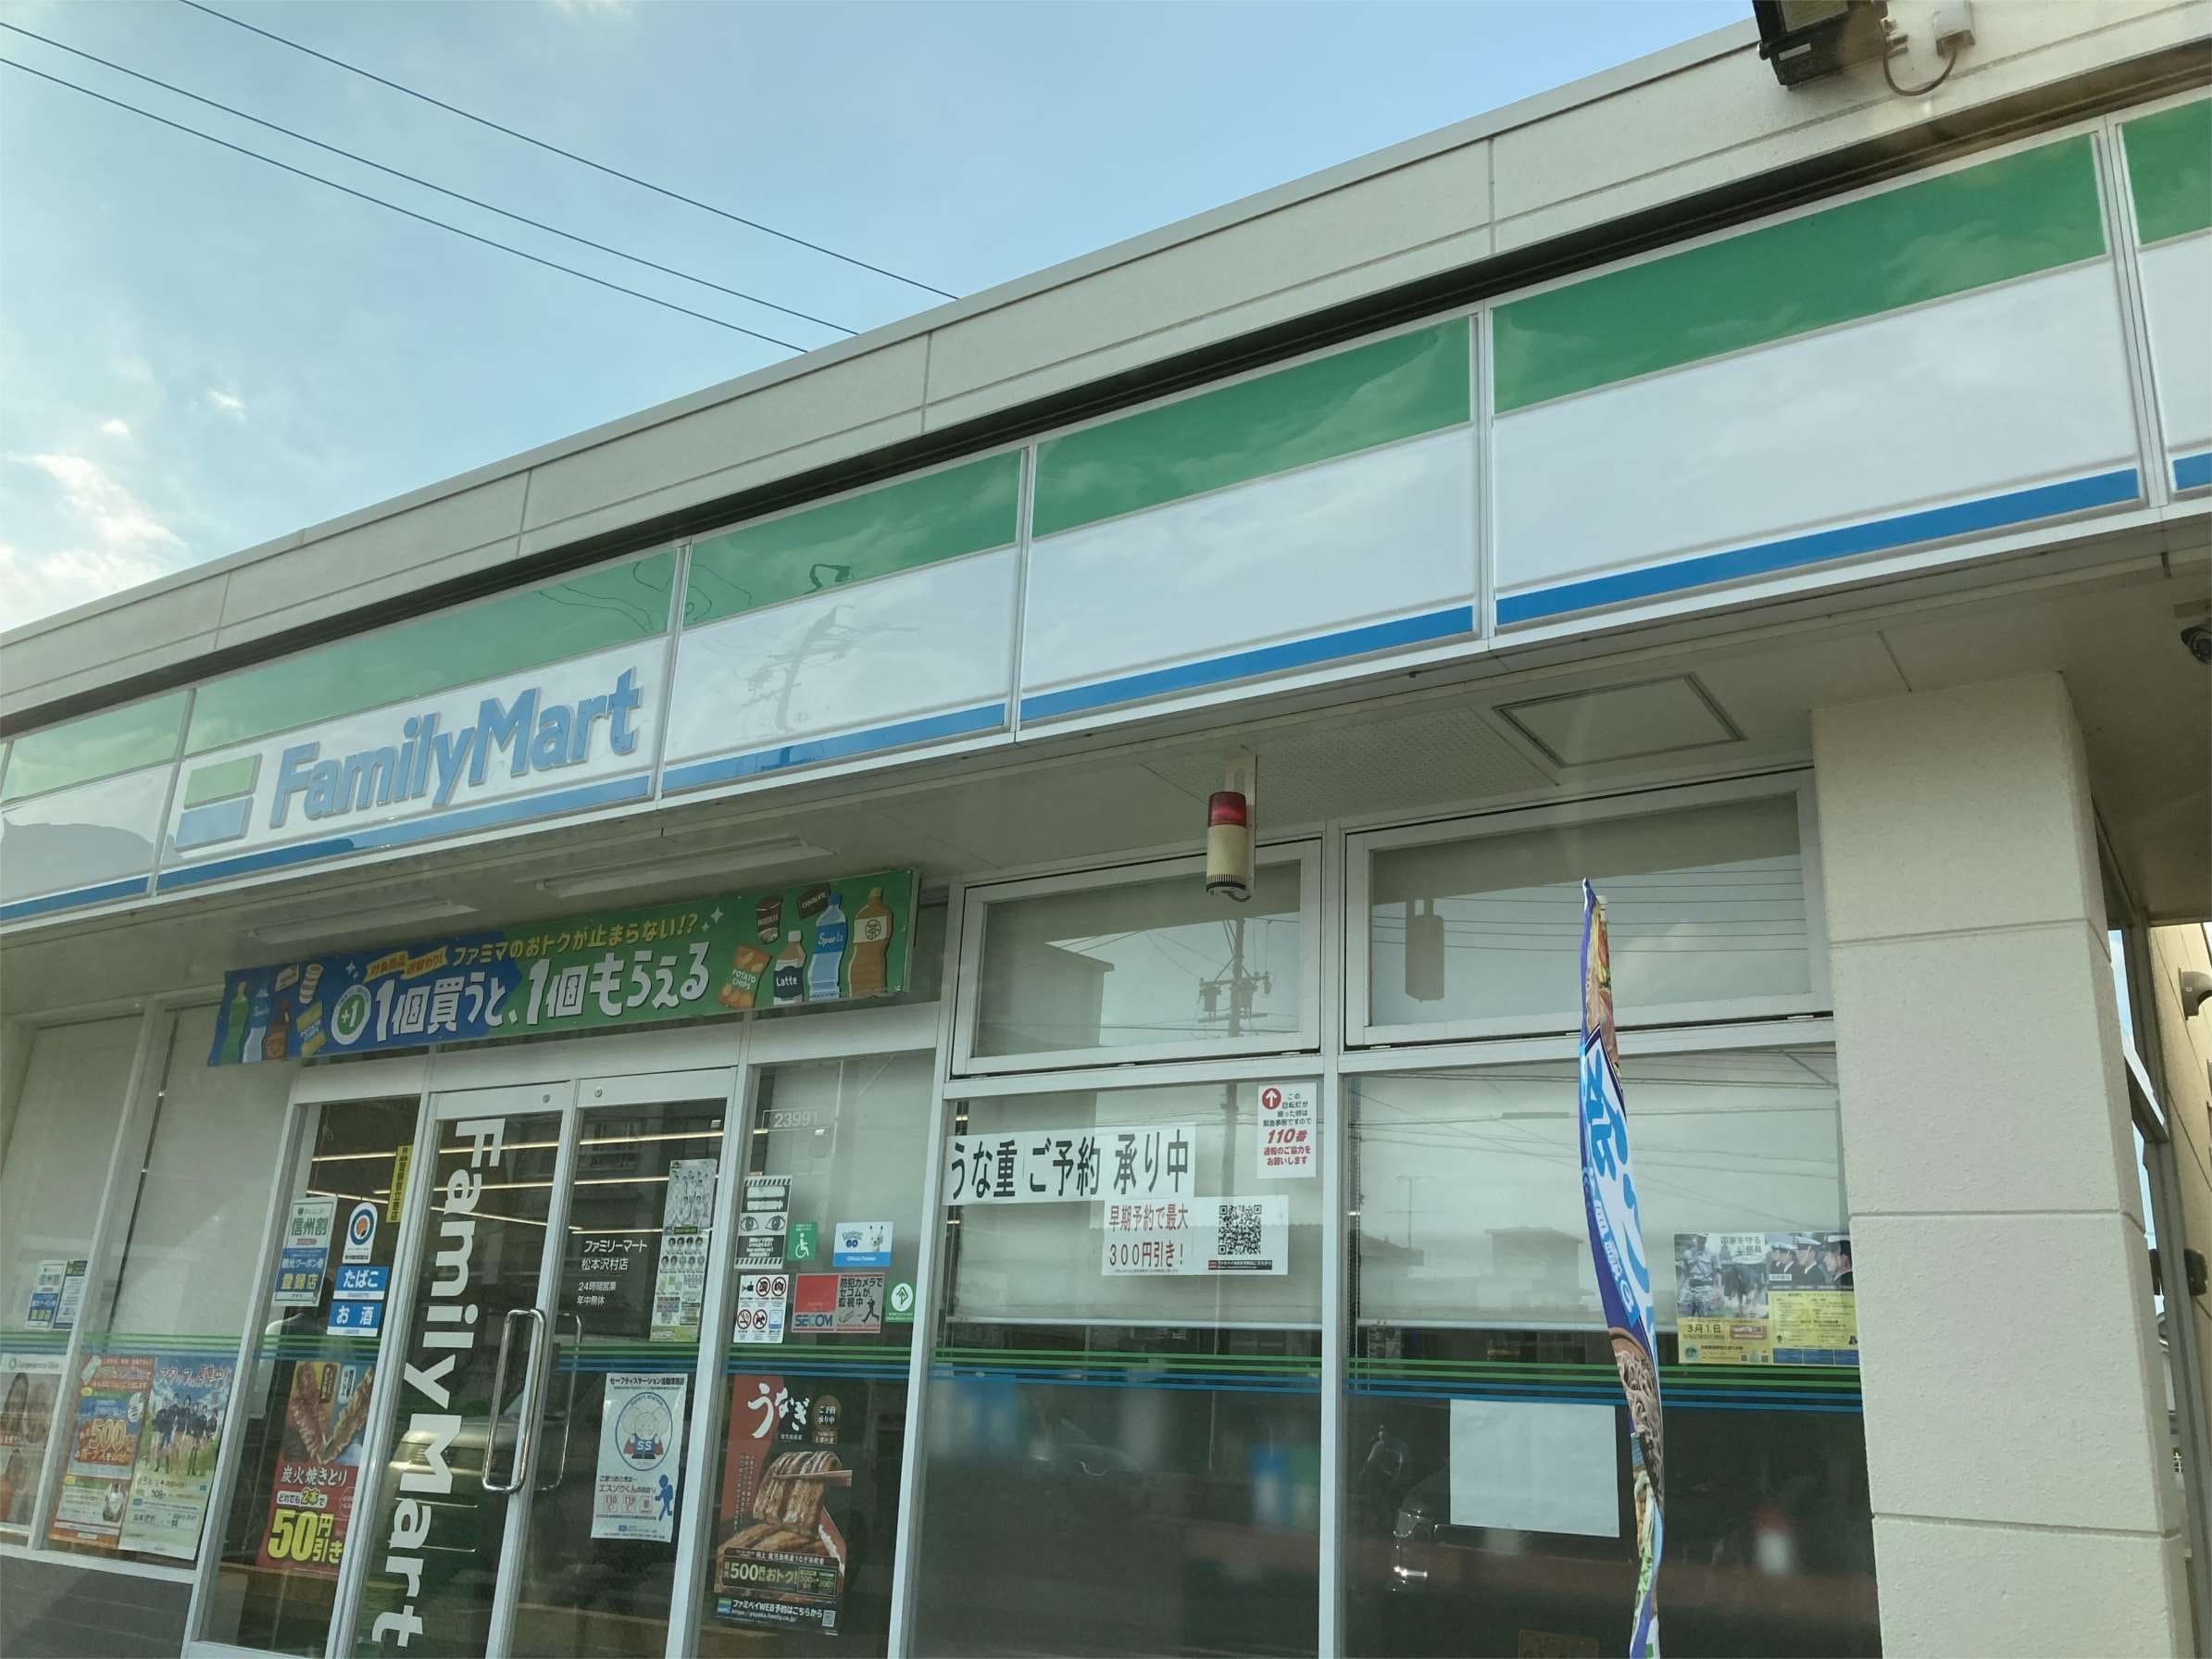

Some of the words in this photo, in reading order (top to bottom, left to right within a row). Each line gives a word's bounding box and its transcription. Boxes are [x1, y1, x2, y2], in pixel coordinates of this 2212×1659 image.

[269, 667, 643, 829] FamilyMart
[818, 931, 844, 947] Sports
[731, 968, 756, 984] POTATO
[776, 975, 798, 988] Latte
[375, 941, 710, 1042] 1個買うと、1個もらえる
[731, 978, 751, 991] CHIPS
[1267, 1128, 1308, 1144] 110番
[951, 1139, 1018, 1201] うな重
[1029, 1136, 1101, 1197] ご予約
[1112, 1129, 1189, 1195] 承り中
[1266, 1155, 1308, 1166] お願いします
[1108, 1203, 1189, 1232] 早期予約で最大
[291, 1216, 329, 1238] 信州割
[583, 1239, 648, 1254] ファミリーマート
[845, 1239, 858, 1248] GO
[581, 1258, 630, 1272] 松本沢村店
[343, 1269, 380, 1289] たばこ
[840, 1277, 883, 1289] 防犯カメラで
[576, 1295, 606, 1307] 年中無休
[840, 1288, 870, 1298] セコムが
[838, 1297, 865, 1308] 監視中
[794, 1313, 833, 1328] SECOM
[371, 1117, 506, 1647] FamilyMart
[747, 1382, 810, 1439] うなぎ
[636, 1441, 653, 1452] SS
[281, 1465, 348, 1487] 炭火焼きとり
[267, 1508, 344, 1565] 50円引き
